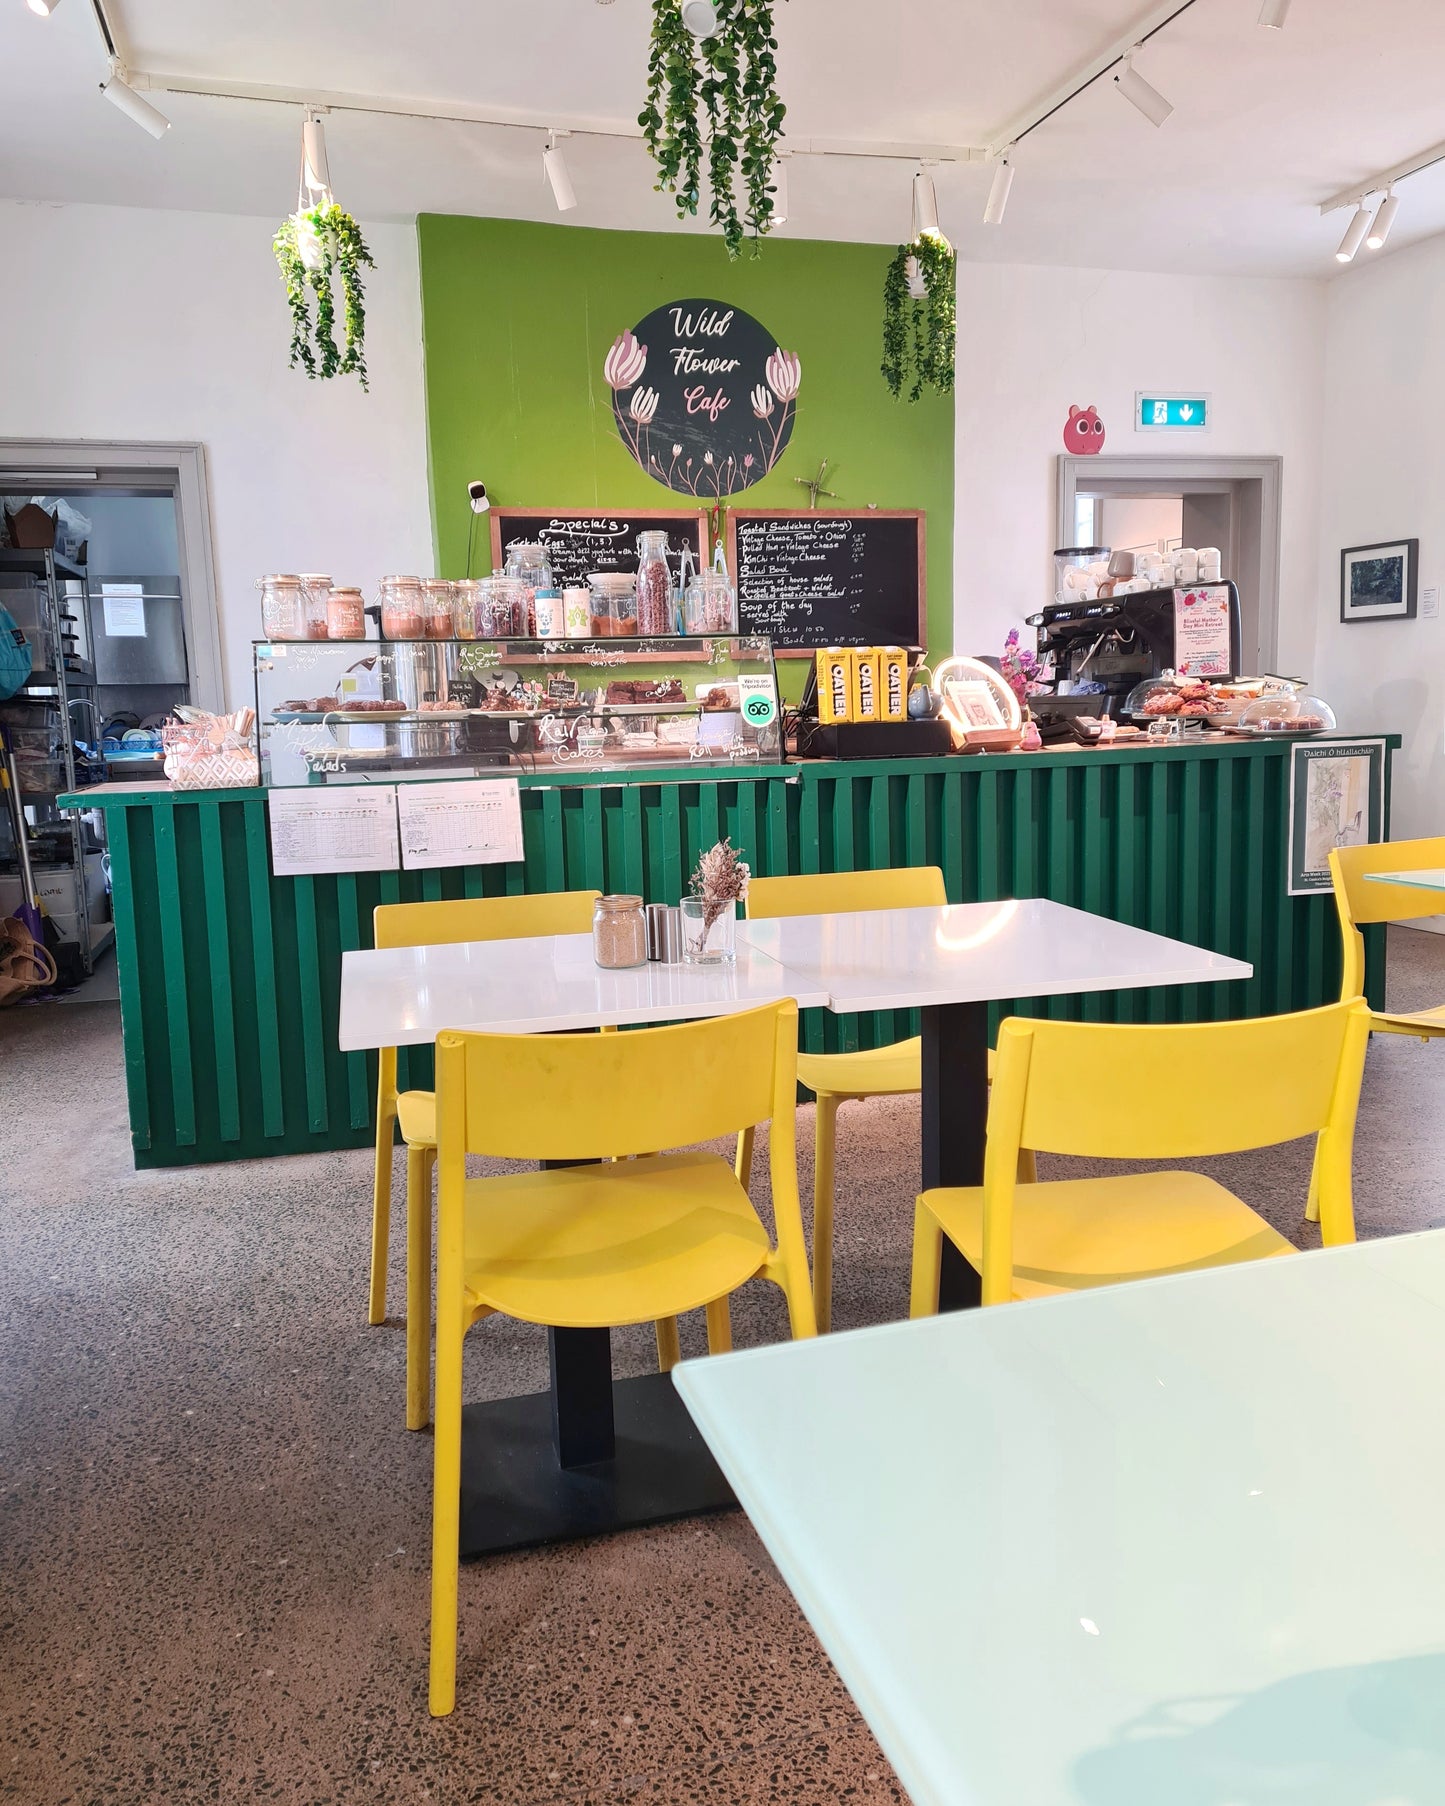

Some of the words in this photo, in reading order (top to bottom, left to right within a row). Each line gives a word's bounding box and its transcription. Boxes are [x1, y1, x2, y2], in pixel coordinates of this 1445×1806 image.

[669, 307, 734, 337] Wild
[669, 346, 740, 375] Flower
[684, 385, 731, 422] Cafe
[550, 519, 618, 535] Special's
[738, 521, 768, 534] Toasted
[769, 521, 812, 532] Sandwiches
[794, 532, 817, 541] Tomato
[825, 531, 847, 541] Onion
[786, 541, 810, 552] Vintage
[812, 541, 839, 550] Cheese
[798, 552, 827, 562] Cheese
[739, 564, 767, 577] Salad
[776, 577, 785, 585] of
[740, 602, 763, 612] Soup
[767, 601, 778, 613] of
[781, 600, 796, 610] the
[798, 599, 813, 616] day
[831, 663, 846, 717] OATIER
[859, 662, 873, 716] OATIER
[888, 662, 902, 716] OATIER
[558, 740, 605, 760] Cakes
[303, 753, 347, 777] Salads
